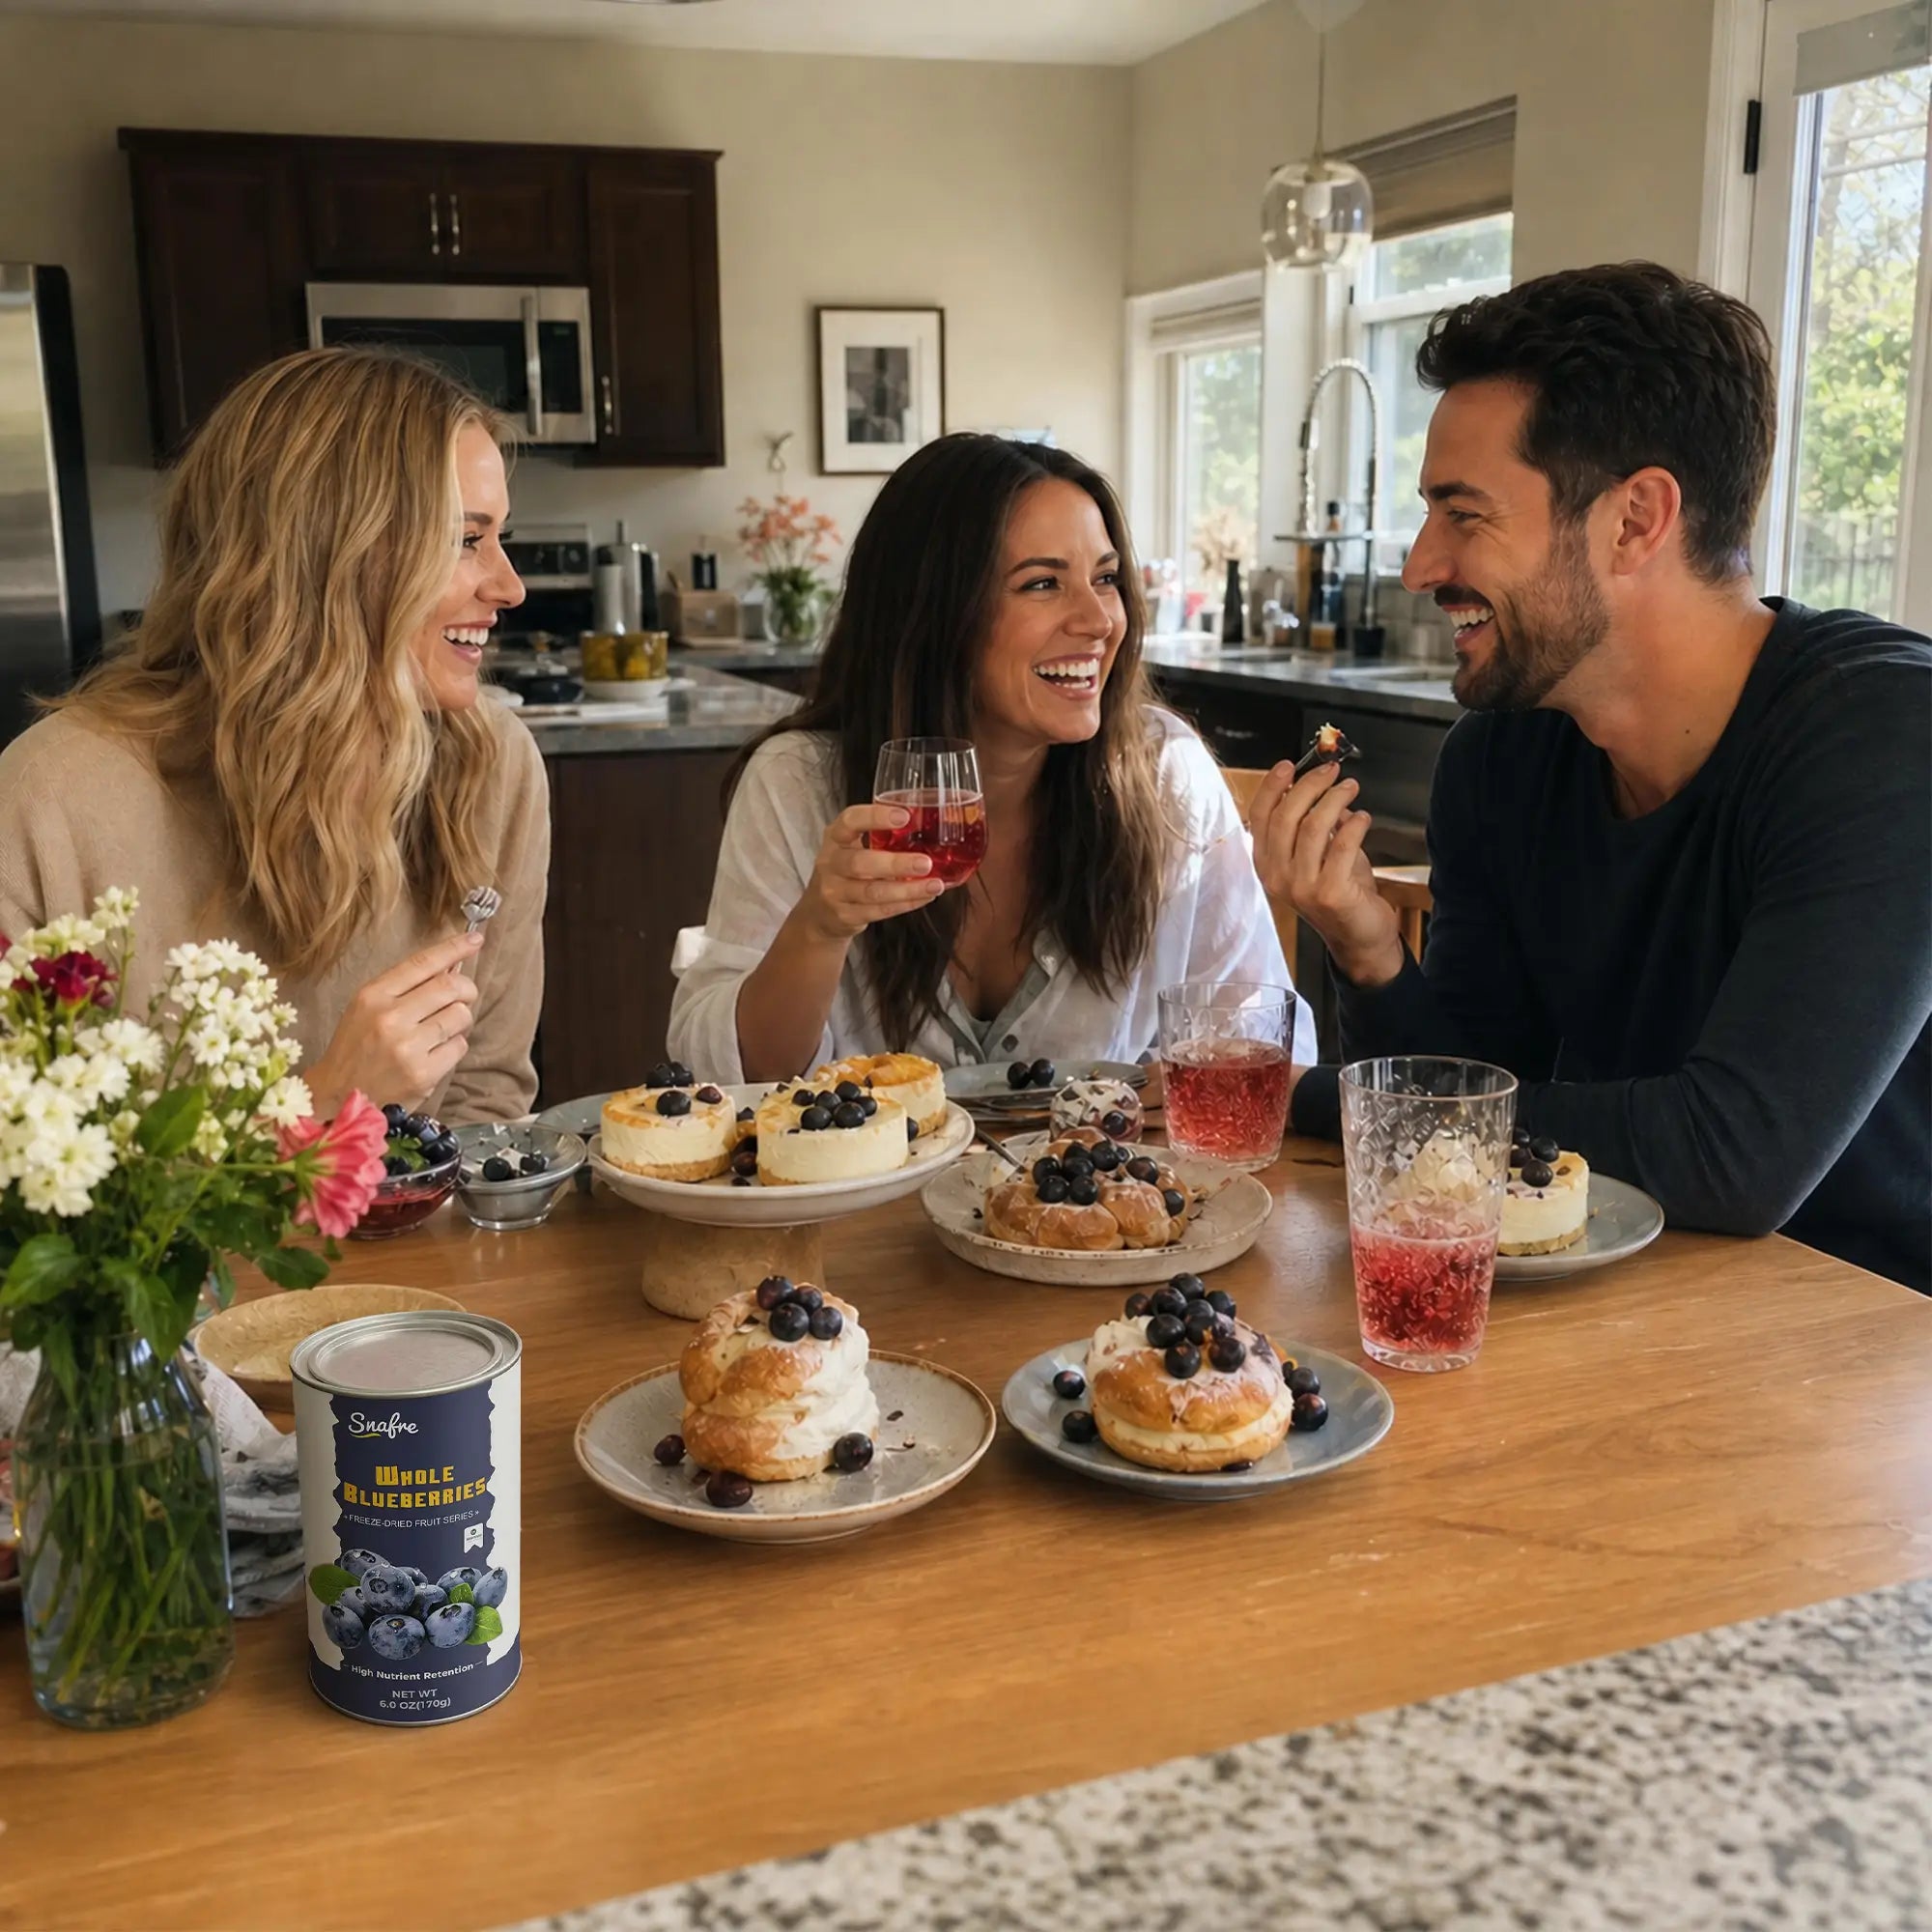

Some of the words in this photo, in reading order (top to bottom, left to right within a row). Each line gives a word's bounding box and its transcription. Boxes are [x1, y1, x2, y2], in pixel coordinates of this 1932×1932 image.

[348, 1411, 419, 1439] Snafre
[349, 1514, 412, 1528] FREEZE-DRIED
[414, 1518, 441, 1527] FRUIT
[442, 1510, 473, 1524] SERIES
[351, 1664, 374, 1677] High
[376, 1670, 421, 1681] Nutrient
[424, 1663, 473, 1680] Retention
[392, 1690, 415, 1699] NET
[418, 1689, 438, 1697] WT
[379, 1700, 397, 1709] 6.0
